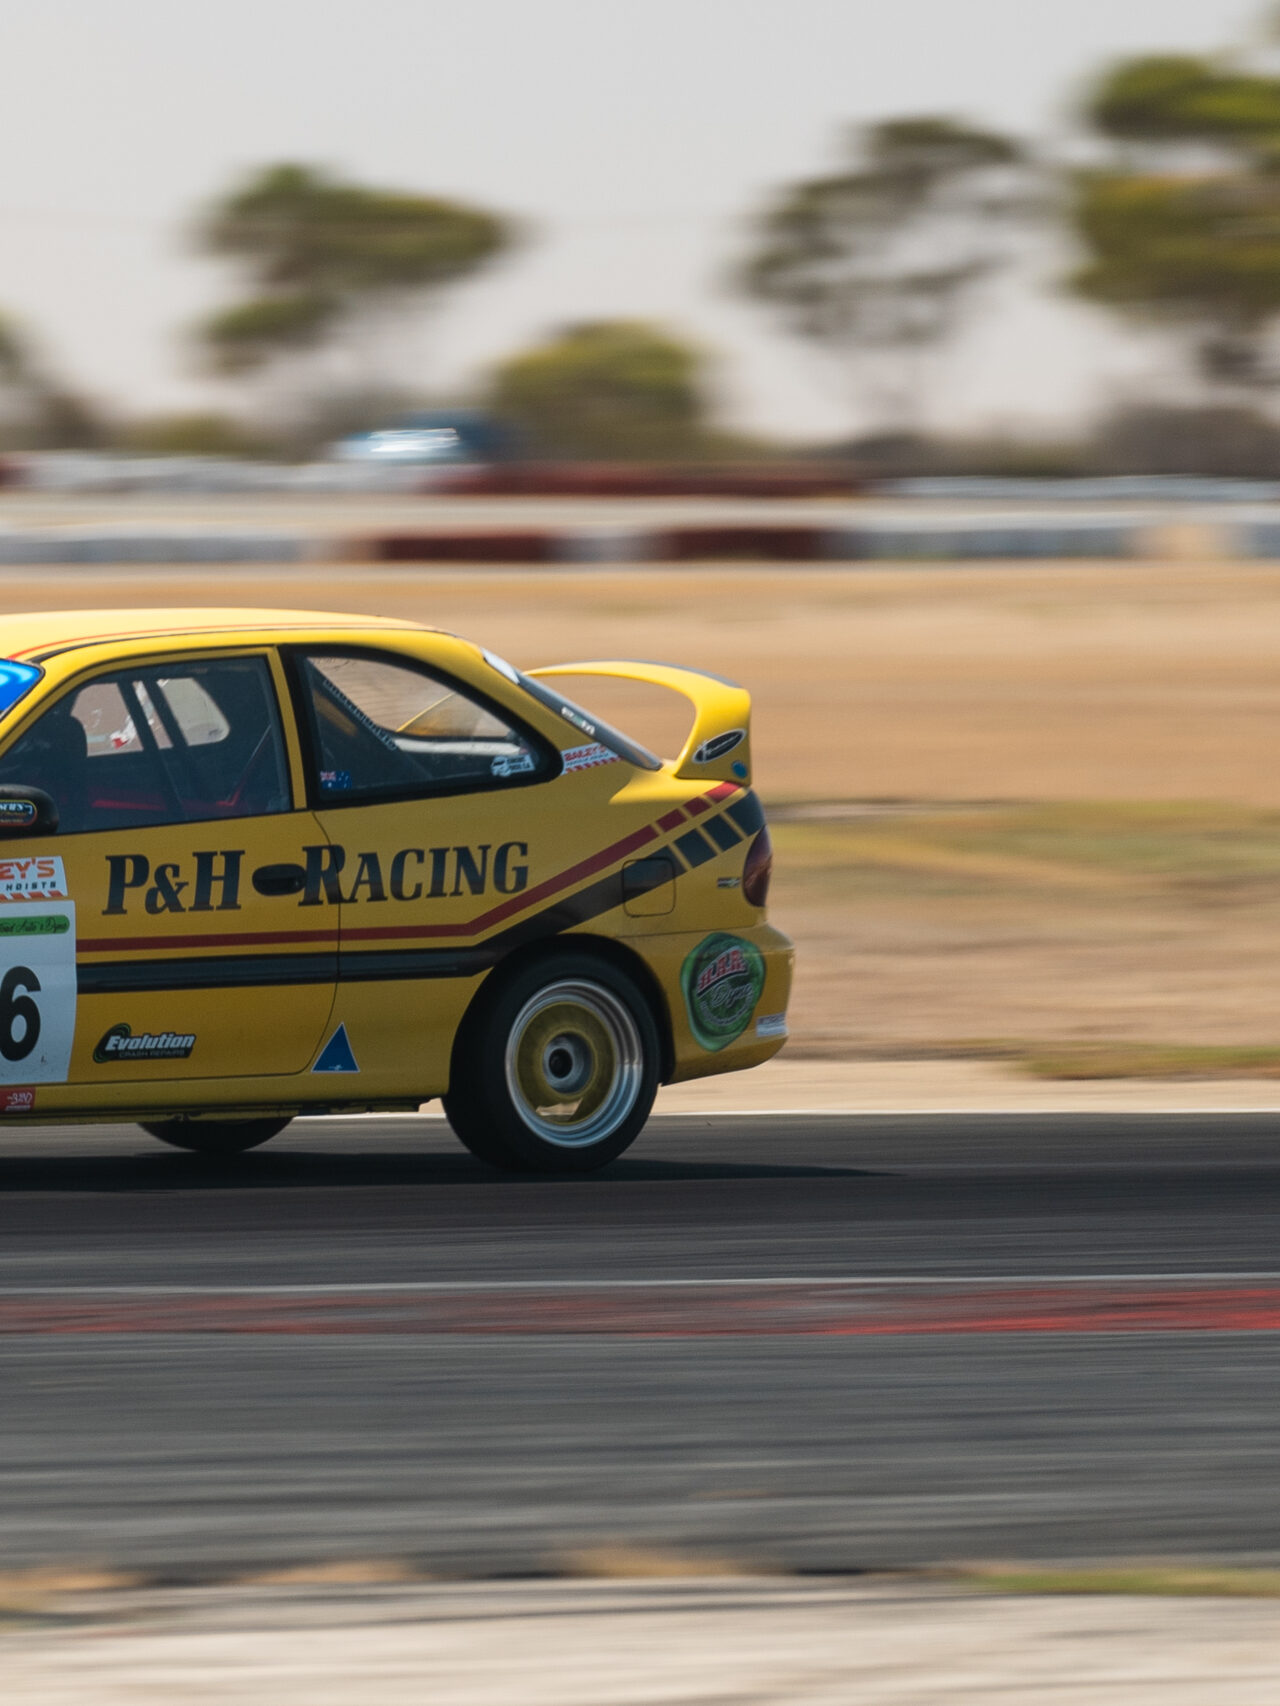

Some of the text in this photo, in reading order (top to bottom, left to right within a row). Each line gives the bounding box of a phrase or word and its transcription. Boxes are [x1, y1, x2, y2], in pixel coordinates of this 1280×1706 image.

[6, 881, 57, 892] HOISTS
[101, 850, 245, 915] P&H
[105, 1033, 195, 1051] Evolution
